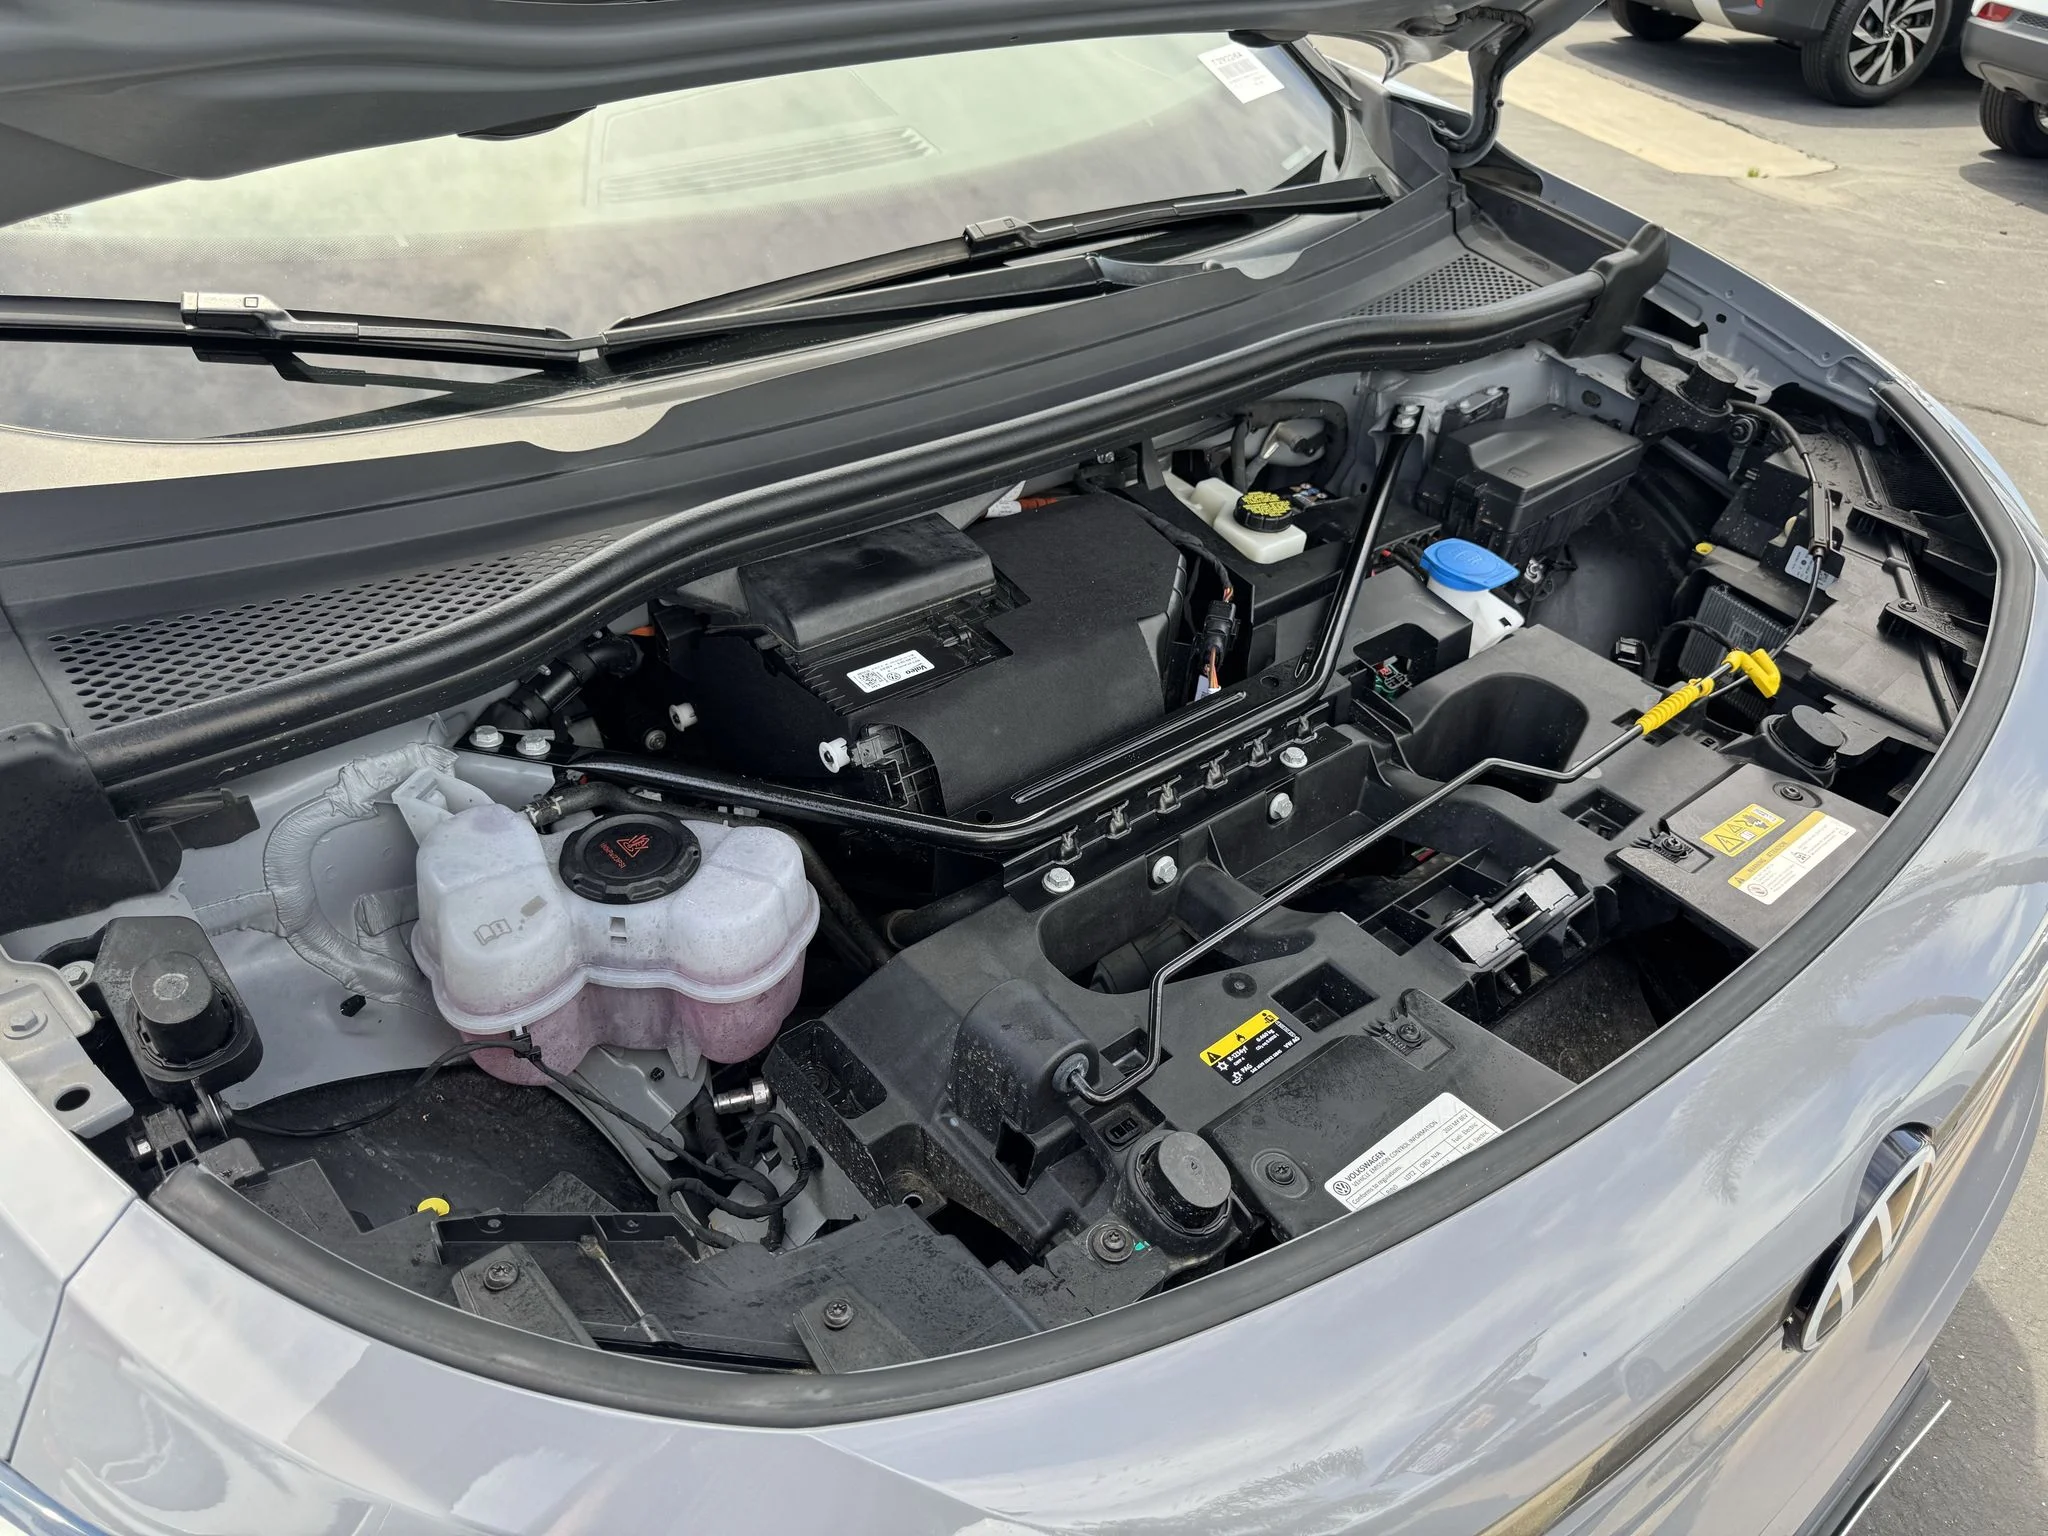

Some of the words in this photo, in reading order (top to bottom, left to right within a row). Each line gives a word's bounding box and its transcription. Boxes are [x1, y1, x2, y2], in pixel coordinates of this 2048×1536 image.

[1283, 1040, 1294, 1048] VW
[1240, 1063, 1253, 1073] PAG
[1352, 1171, 1370, 1188] VEHICLE
[1369, 1156, 1390, 1174] EMISSION
[1389, 1142, 1410, 1158] CONTROL
[1409, 1120, 1438, 1144] INFORMATION
[1344, 1150, 1386, 1182] VOLKSWAGEN
[1352, 1186, 1374, 1204] Conforms
